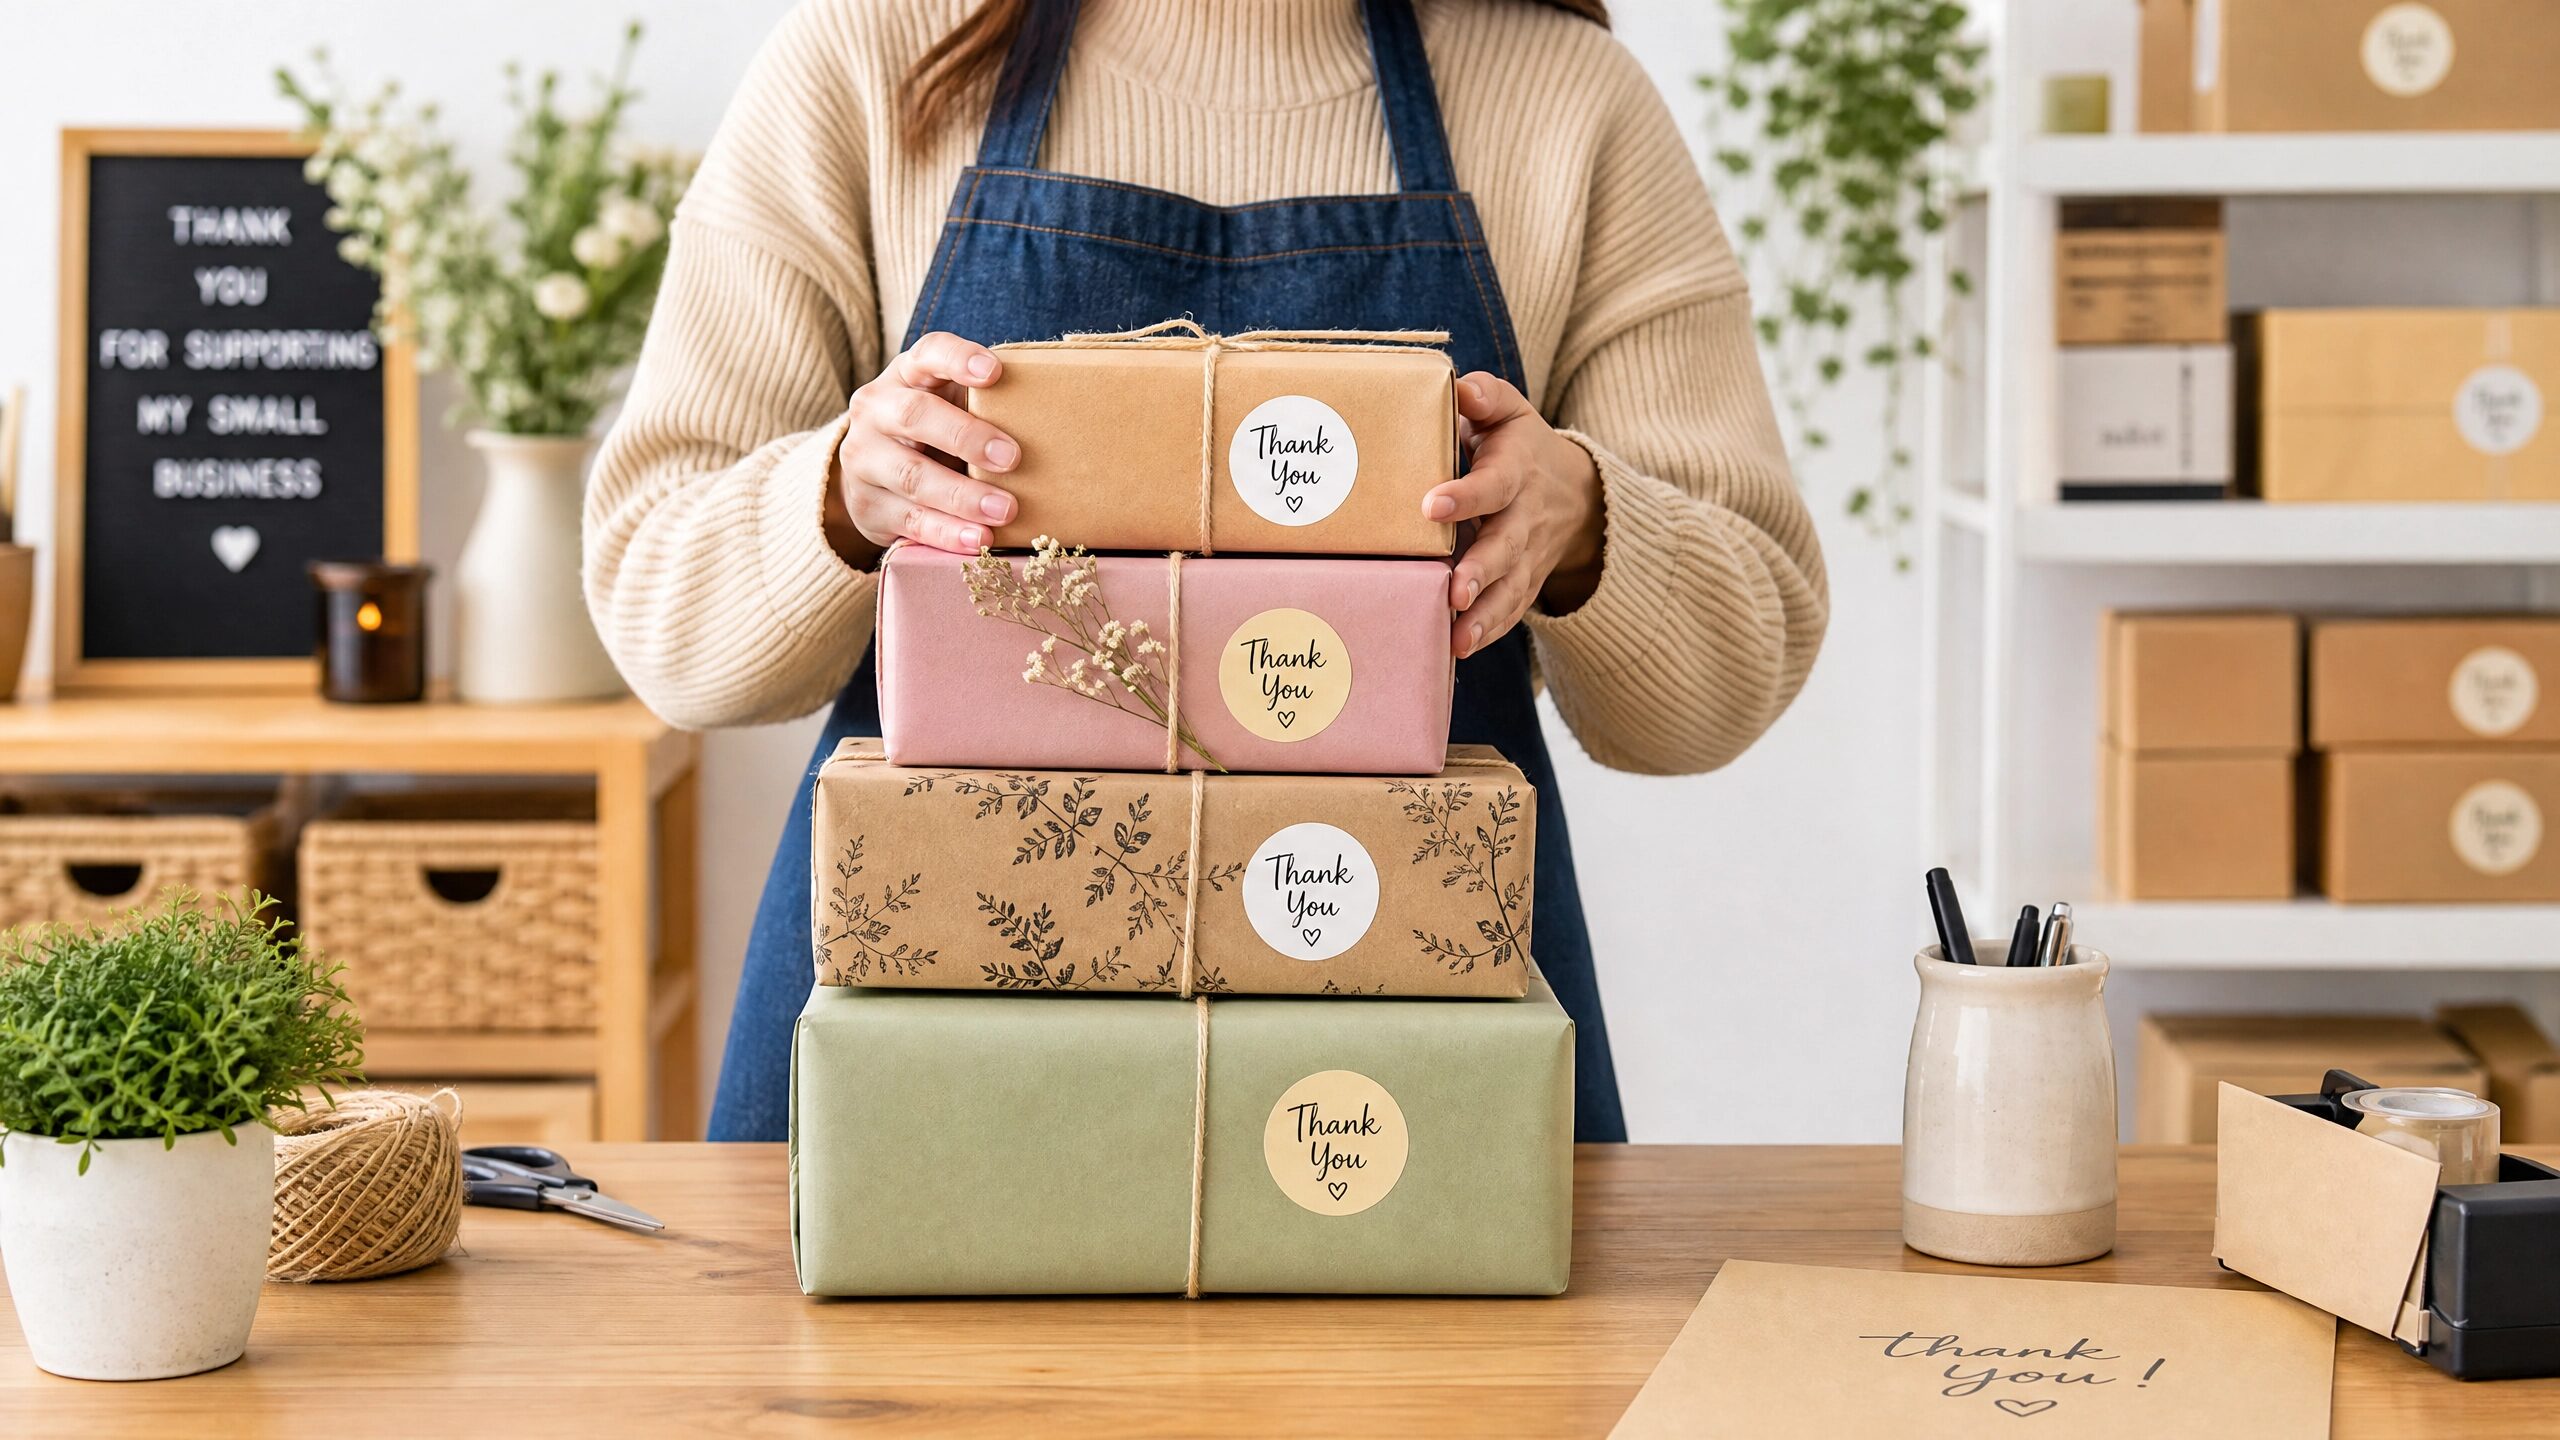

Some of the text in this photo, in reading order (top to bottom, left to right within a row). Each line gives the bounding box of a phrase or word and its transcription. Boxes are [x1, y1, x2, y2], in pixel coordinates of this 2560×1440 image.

[169, 206, 291, 245] THANK
[195, 266, 267, 306] YOU
[100, 329, 379, 370] FOR SUPPORTING
[137, 395, 328, 435] MY SMALL
[1250, 424, 1334, 460] Thank
[153, 457, 323, 498] BUSINESS
[1270, 459, 1321, 496] You
[1240, 638, 1327, 675] Thank
[1262, 673, 1314, 711] You
[1265, 852, 1354, 891] Thank
[1287, 890, 1340, 929] You
[1287, 1103, 1382, 1143] Thank
[1310, 1141, 1367, 1182] You
[1858, 1331, 2121, 1360] thank
[1941, 1364, 2117, 1397] you
